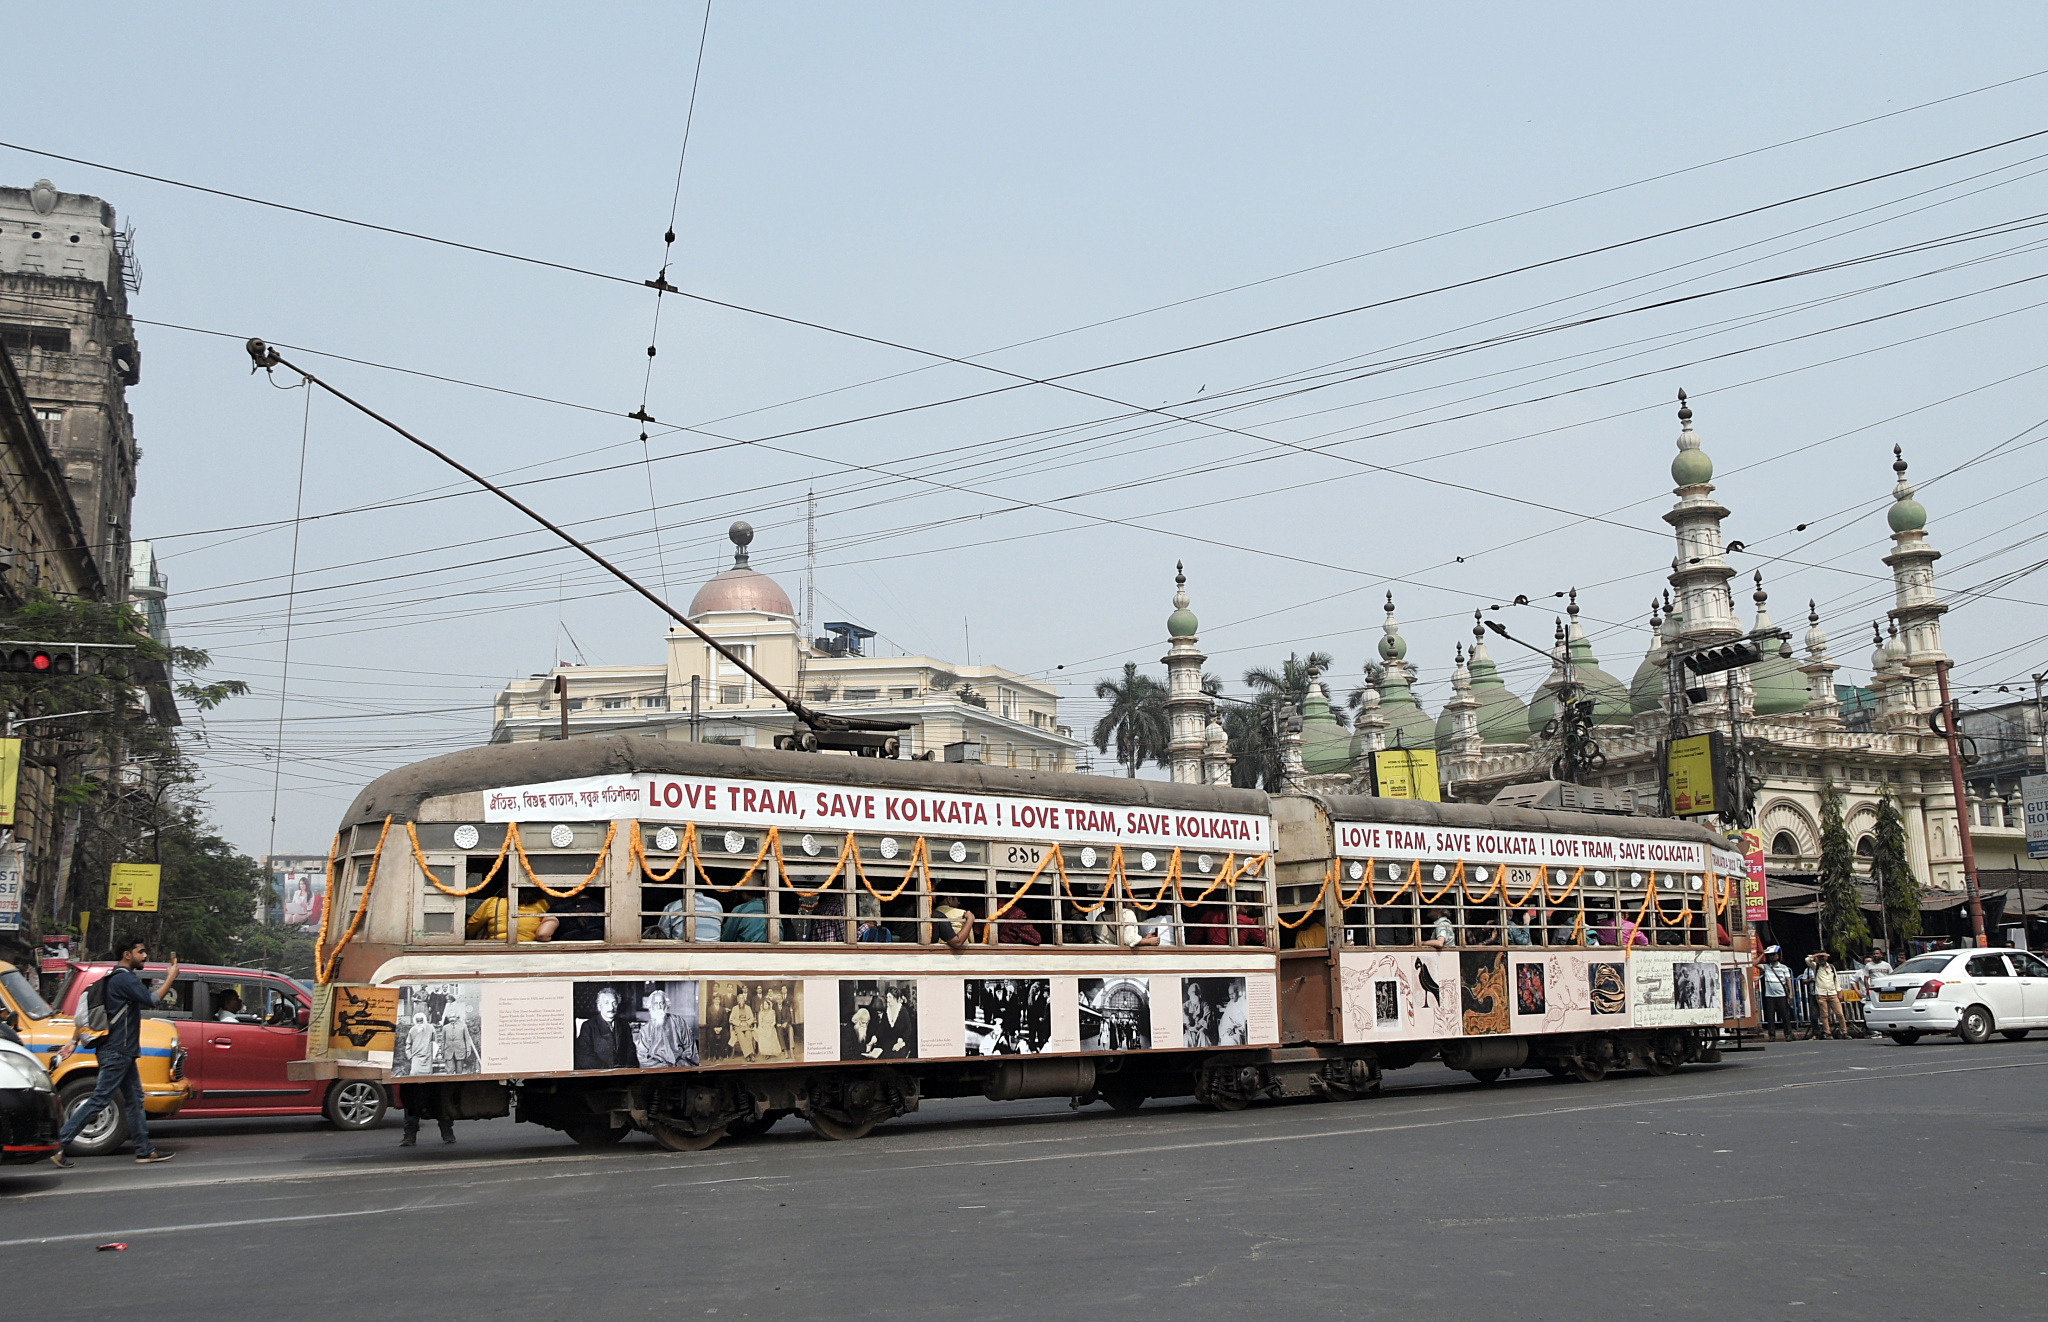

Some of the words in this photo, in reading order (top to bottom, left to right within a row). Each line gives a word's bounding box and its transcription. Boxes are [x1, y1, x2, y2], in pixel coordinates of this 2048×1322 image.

[650, 781, 717, 810] LOVE
[728, 787, 806, 820] TRAM,
[817, 793, 876, 819] SAVE
[886, 797, 988, 825] KOLKATA
[1012, 805, 1060, 829] LOVE
[1065, 809, 1122, 837] TRAM,
[1127, 813, 1170, 836] SAVE
[1176, 816, 1251, 841] KOLKATA
[1342, 827, 1380, 848] LOVE
[1386, 830, 1432, 854] TRAM,
[1437, 833, 1471, 853] SAVE
[1477, 836, 1537, 855] KOLKATA
[1550, 839, 1579, 857] LOVE
[1582, 841, 1617, 860] TRAM,
[1620, 843, 1645, 860] SAVE
[1648, 845, 1694, 862] KOLKATA
